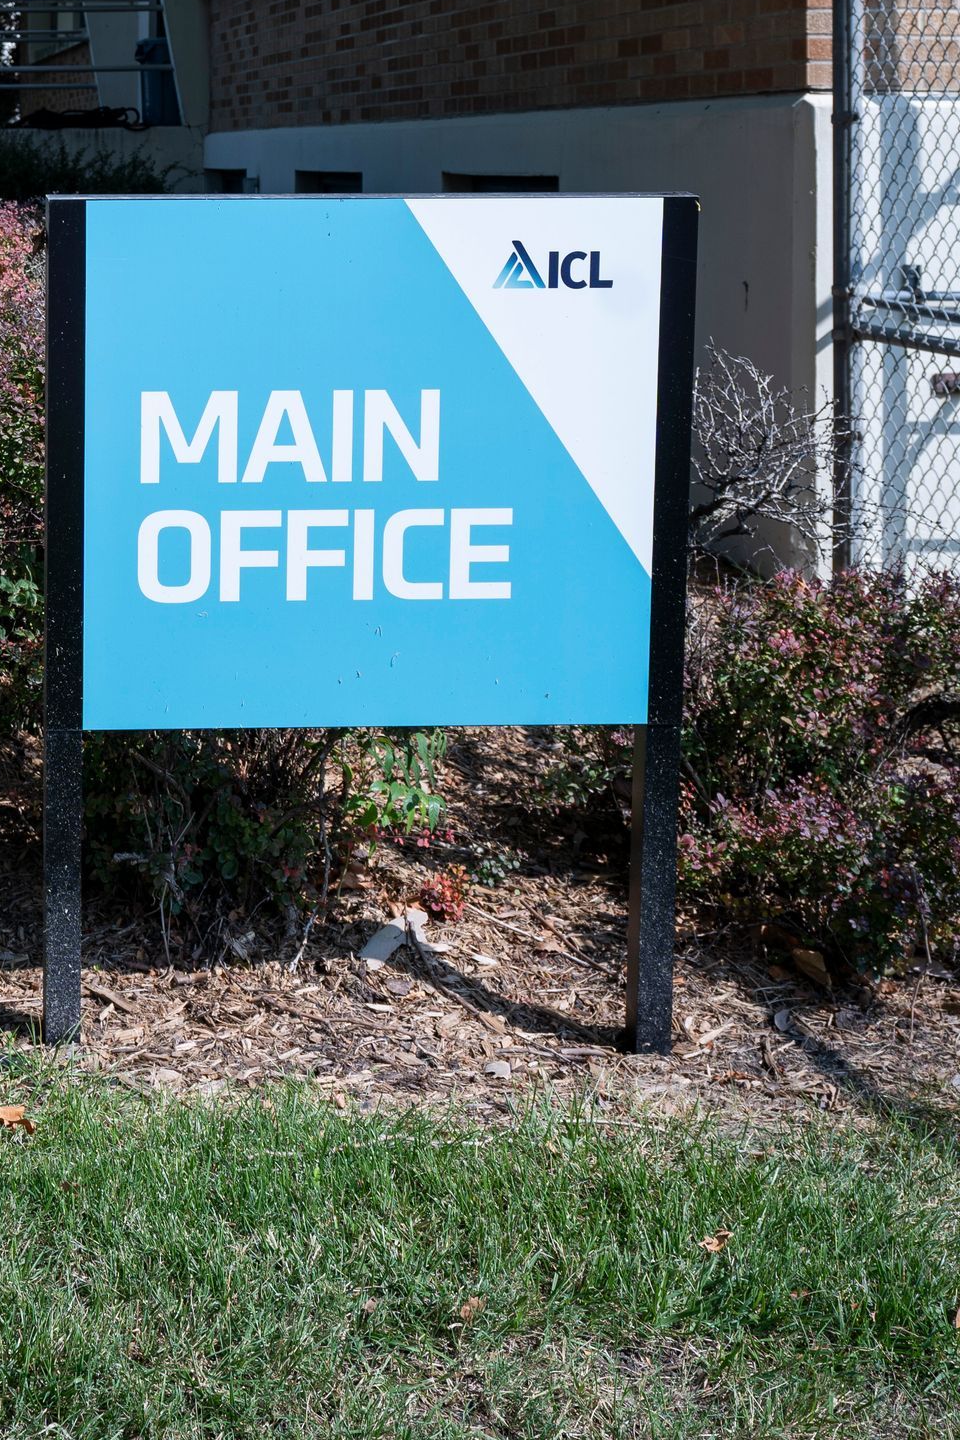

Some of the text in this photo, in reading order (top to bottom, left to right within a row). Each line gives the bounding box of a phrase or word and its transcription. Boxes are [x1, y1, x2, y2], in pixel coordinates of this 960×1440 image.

[548, 251, 613, 289] ICL
[141, 389, 440, 483] MAIN
[137, 508, 513, 603] OFFICE
